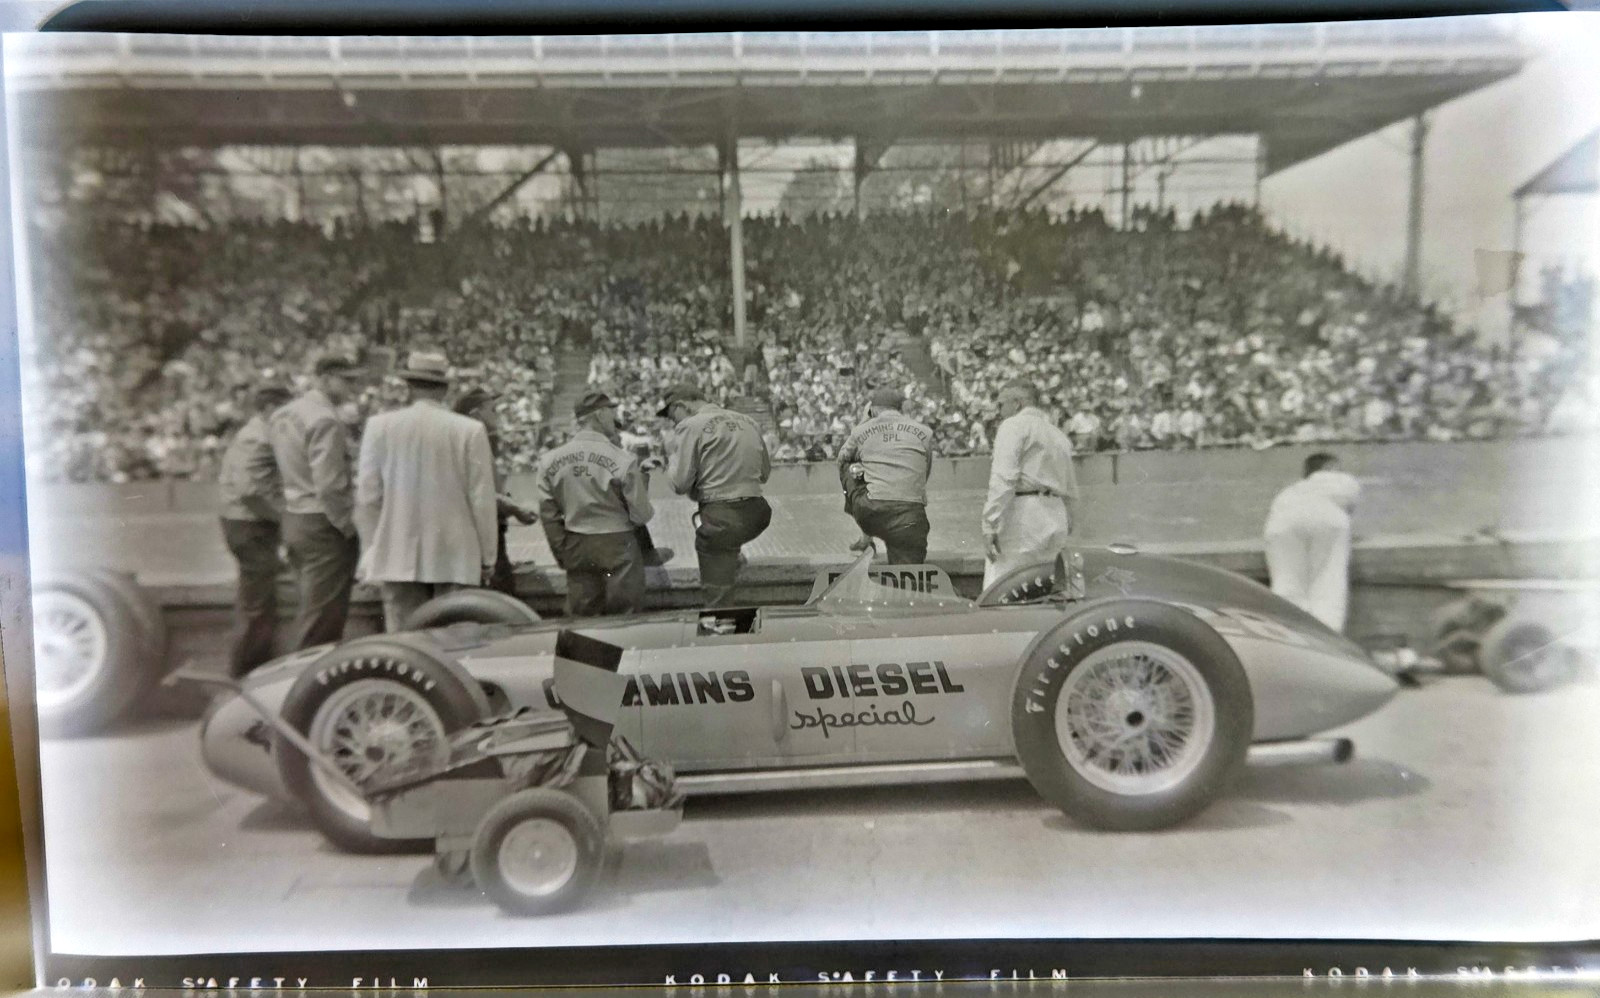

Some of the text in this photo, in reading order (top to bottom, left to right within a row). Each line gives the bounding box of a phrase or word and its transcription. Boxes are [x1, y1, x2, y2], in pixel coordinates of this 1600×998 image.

[856, 423, 928, 446] CUMMINS DIESEL
[882, 433, 903, 442] SPL
[573, 465, 592, 477] SPL
[588, 452, 620, 477] DIESEL
[1025, 616, 1135, 714] Firestone
[542, 661, 965, 709] CMINS DIESEL
[790, 700, 936, 739] special
[665, 972, 781, 985] KODAK
[989, 968, 1067, 980] FILM
[1302, 966, 1418, 978] KODAK
[352, 977, 428, 988] FILM
